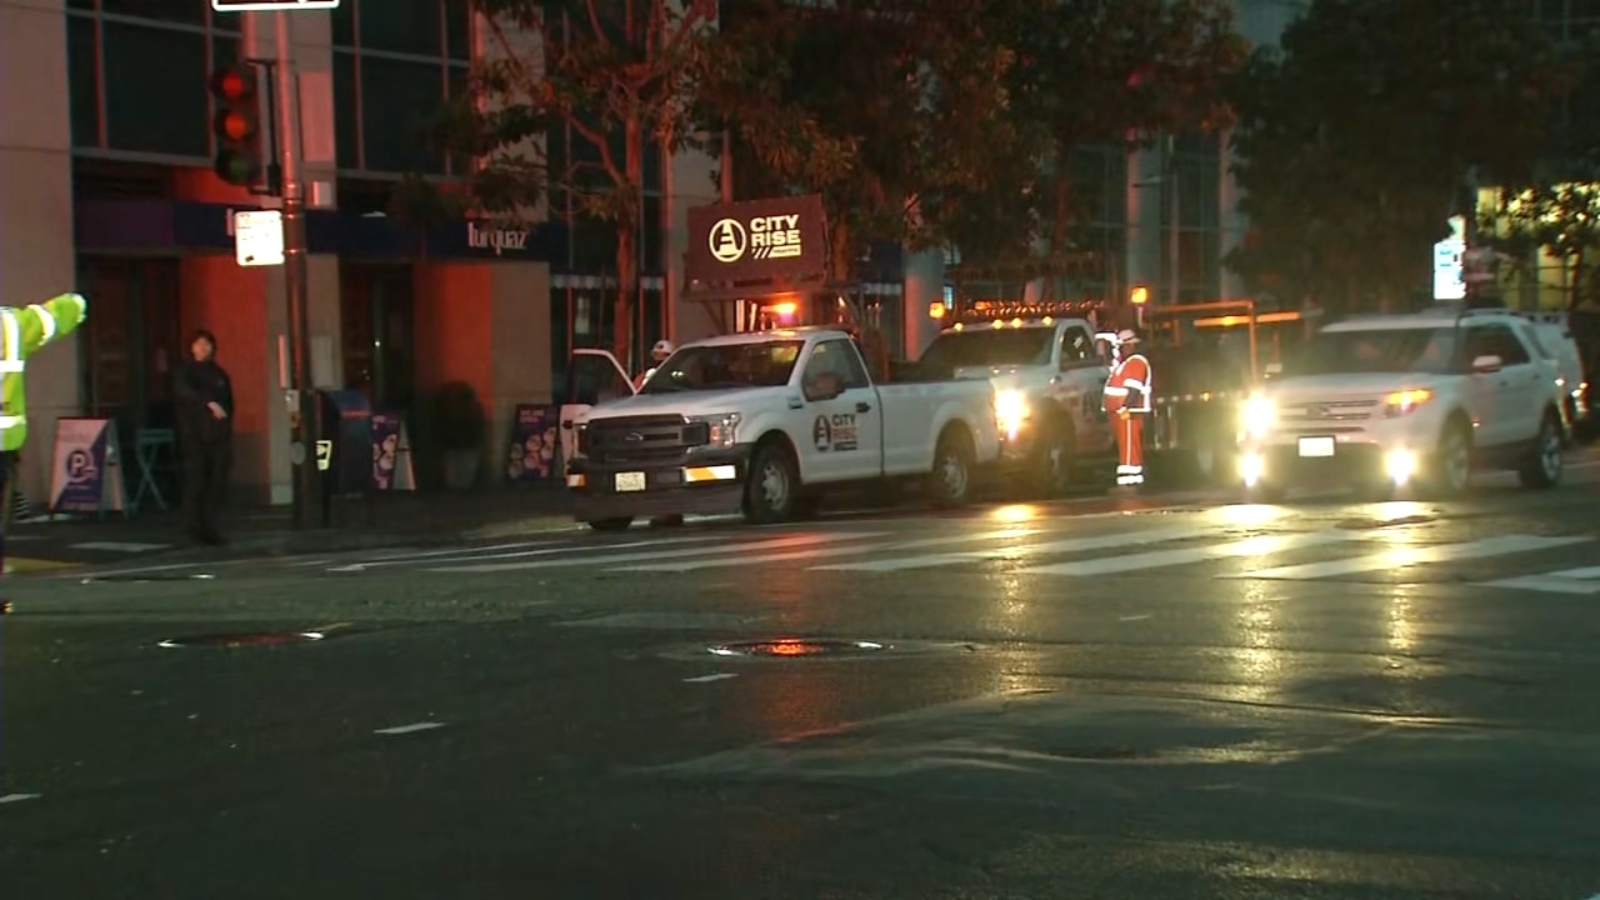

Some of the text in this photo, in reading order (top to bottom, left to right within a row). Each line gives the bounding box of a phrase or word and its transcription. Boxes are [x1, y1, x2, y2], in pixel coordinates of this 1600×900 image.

[750, 214, 799, 232] CITY
[751, 230, 801, 247] RISE
[832, 413, 856, 427] CITY
